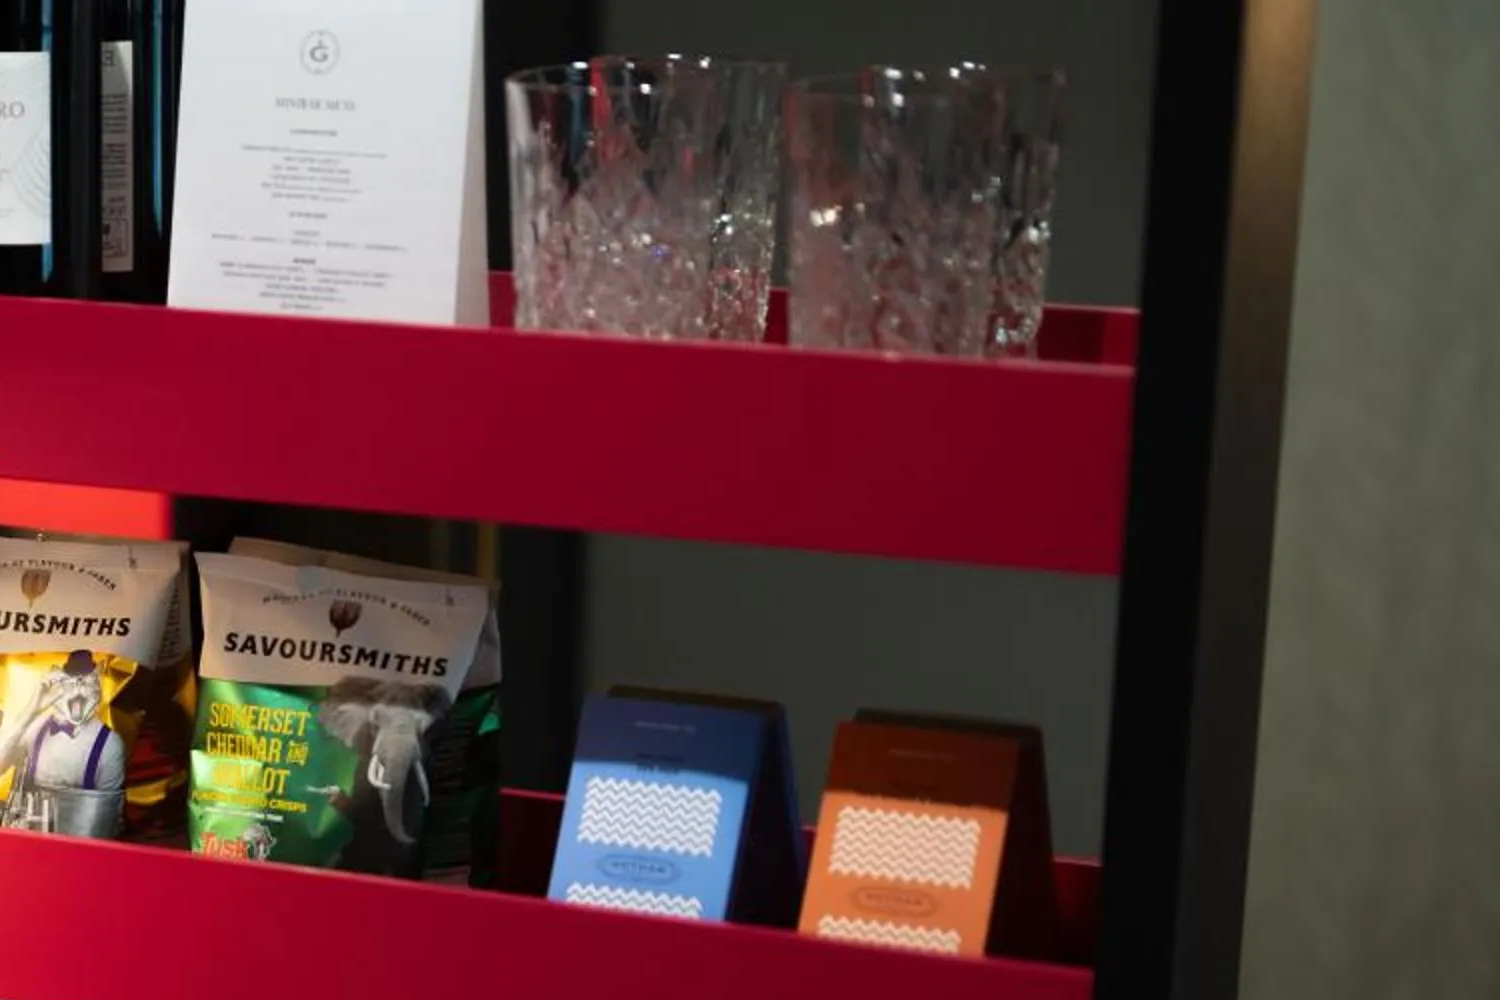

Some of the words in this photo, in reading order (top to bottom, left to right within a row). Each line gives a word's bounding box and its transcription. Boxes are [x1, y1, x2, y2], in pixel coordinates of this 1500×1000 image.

[224, 631, 450, 677] SAVOURSMITHS
[210, 703, 312, 736] SOMERSET
[207, 731, 283, 763] CHEDDAR
